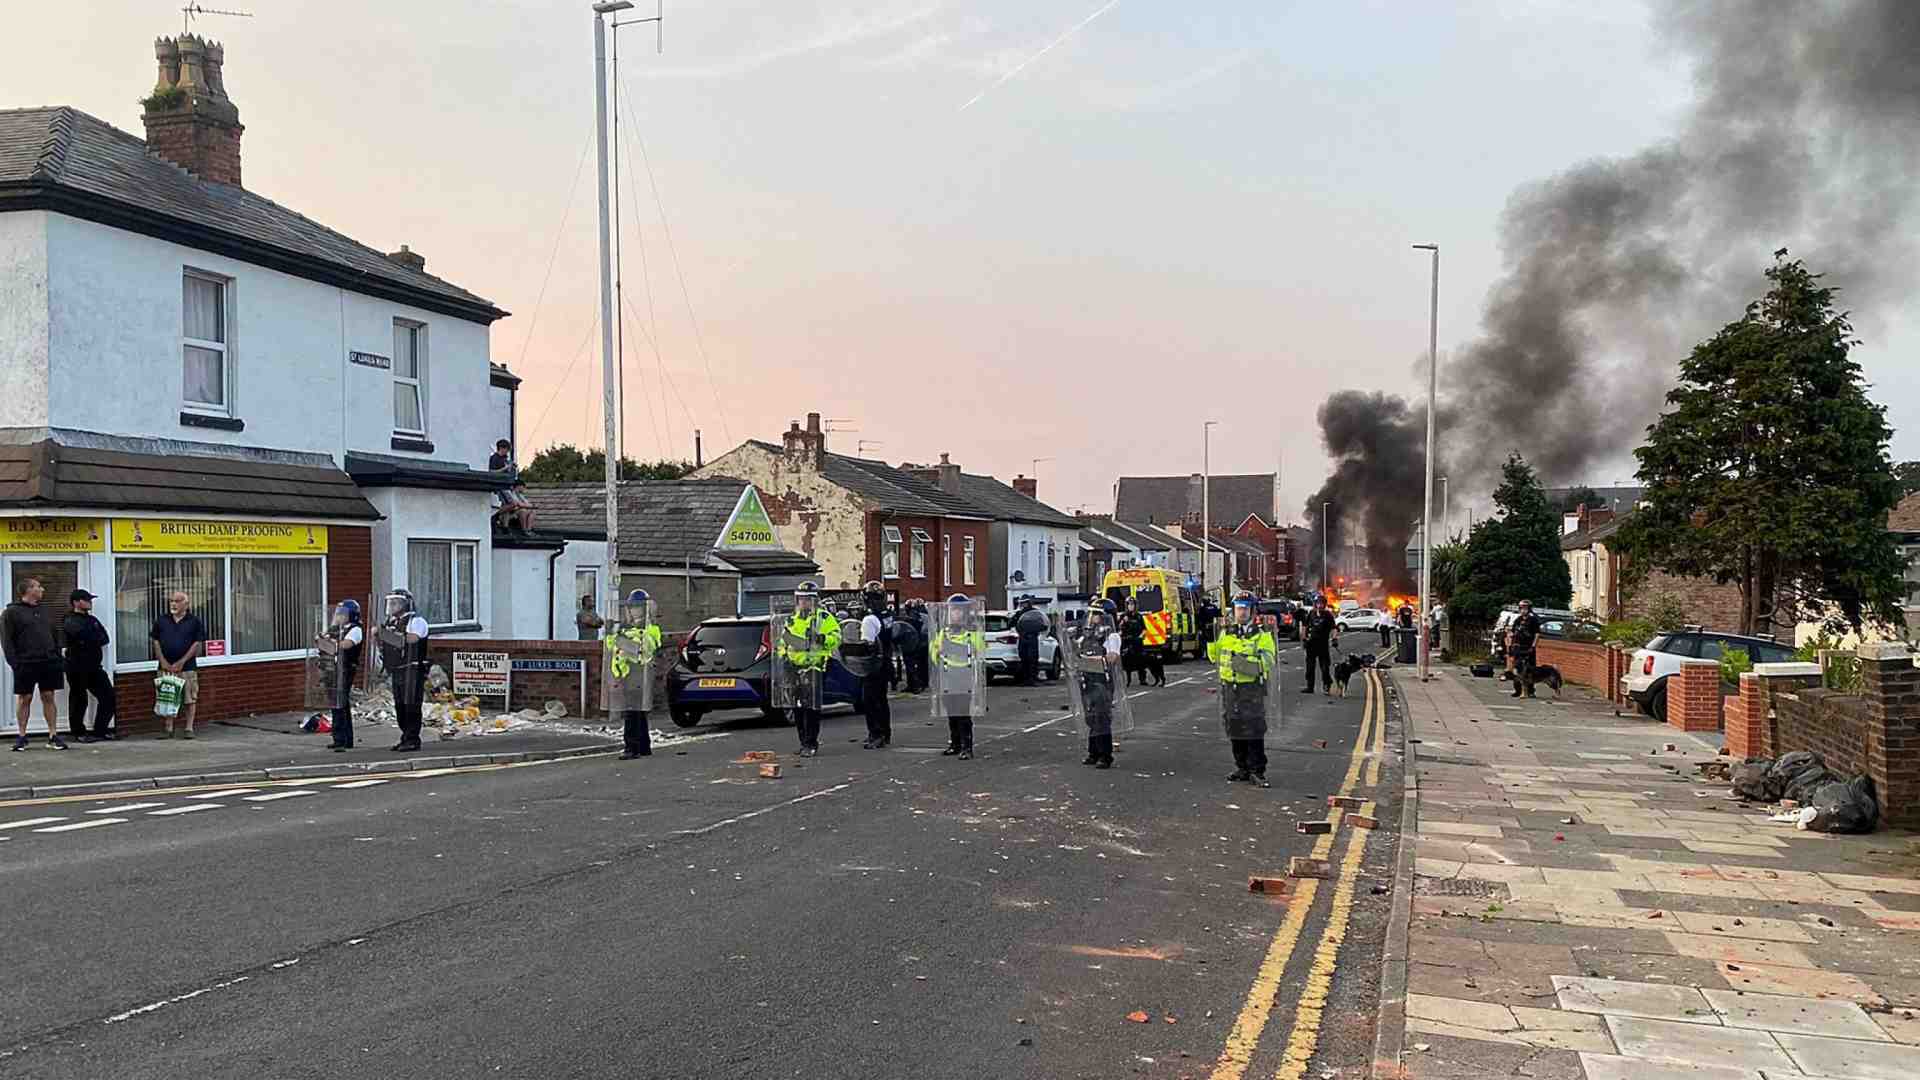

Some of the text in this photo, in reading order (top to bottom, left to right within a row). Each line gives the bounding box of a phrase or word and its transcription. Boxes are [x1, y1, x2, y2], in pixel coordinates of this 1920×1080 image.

[54, 521, 77, 532] Ltd
[161, 523, 292, 536] BRITISH DAMP PROOFING
[731, 531, 772, 541] 547000
